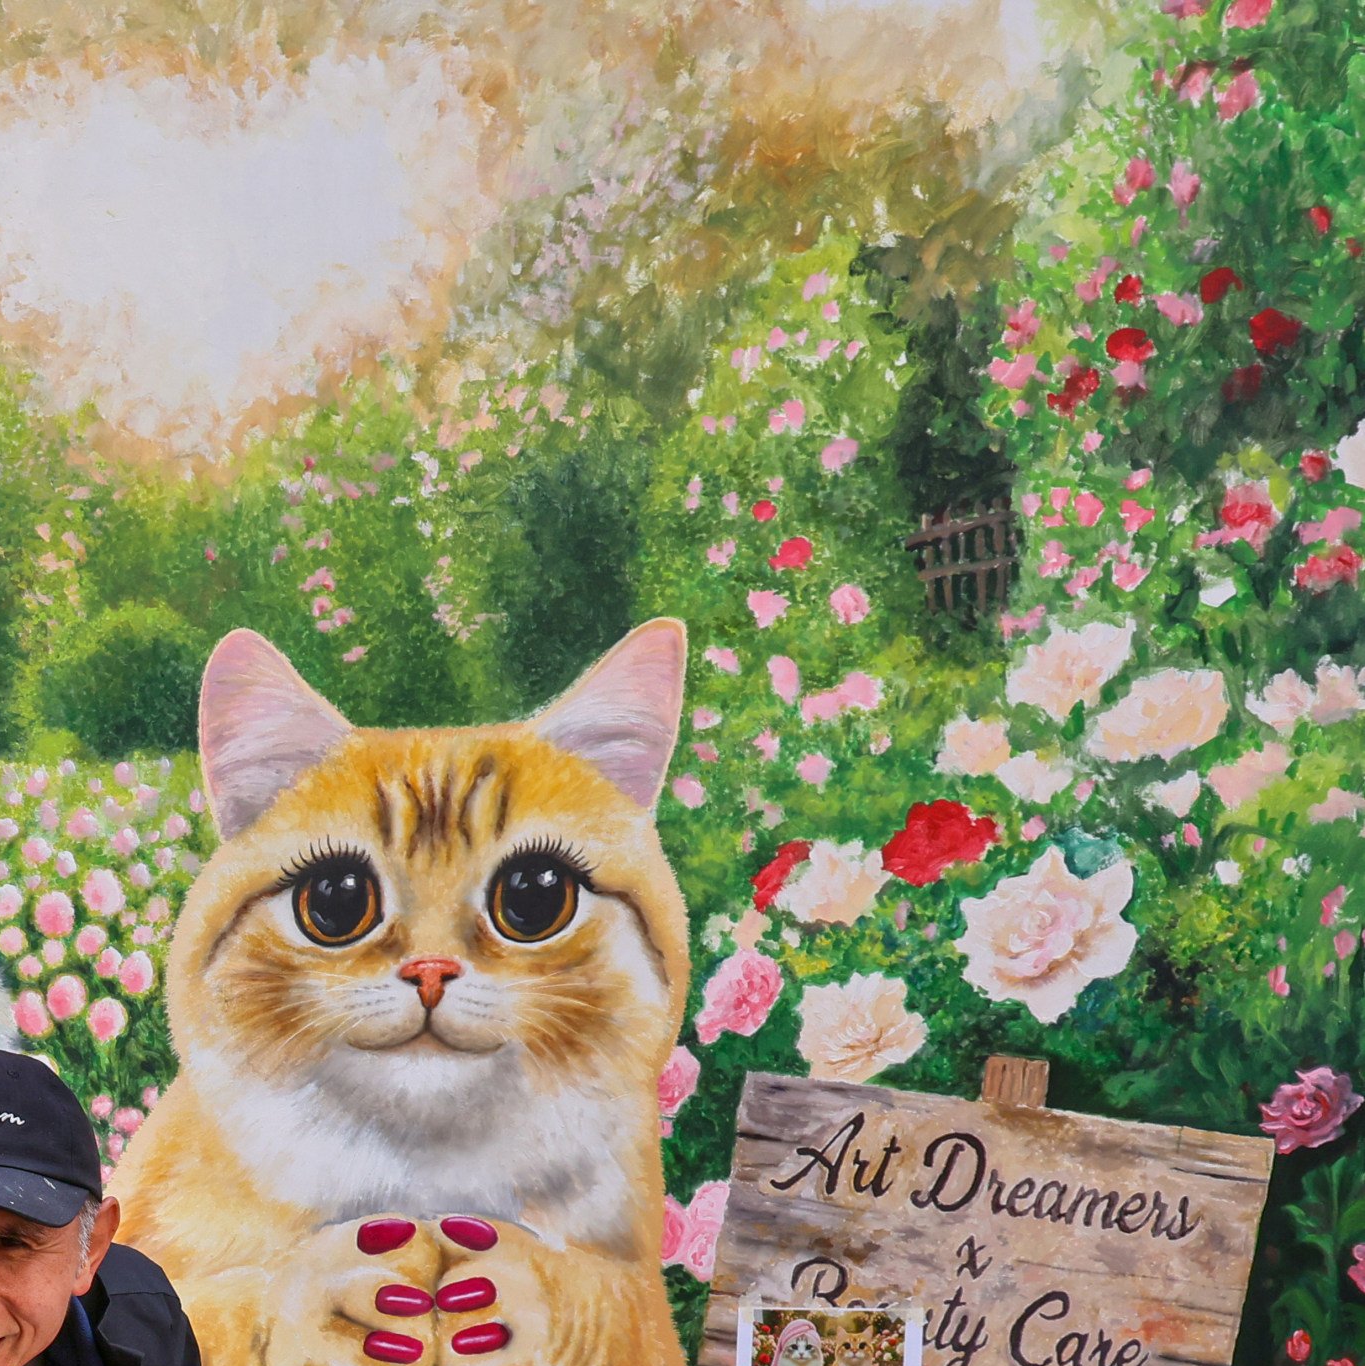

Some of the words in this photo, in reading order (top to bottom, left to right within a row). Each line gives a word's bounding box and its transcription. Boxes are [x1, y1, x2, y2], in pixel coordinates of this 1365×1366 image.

[769, 1111, 902, 1198] Art
[912, 1132, 1201, 1241] Dreamers
[956, 1235, 993, 1279] x
